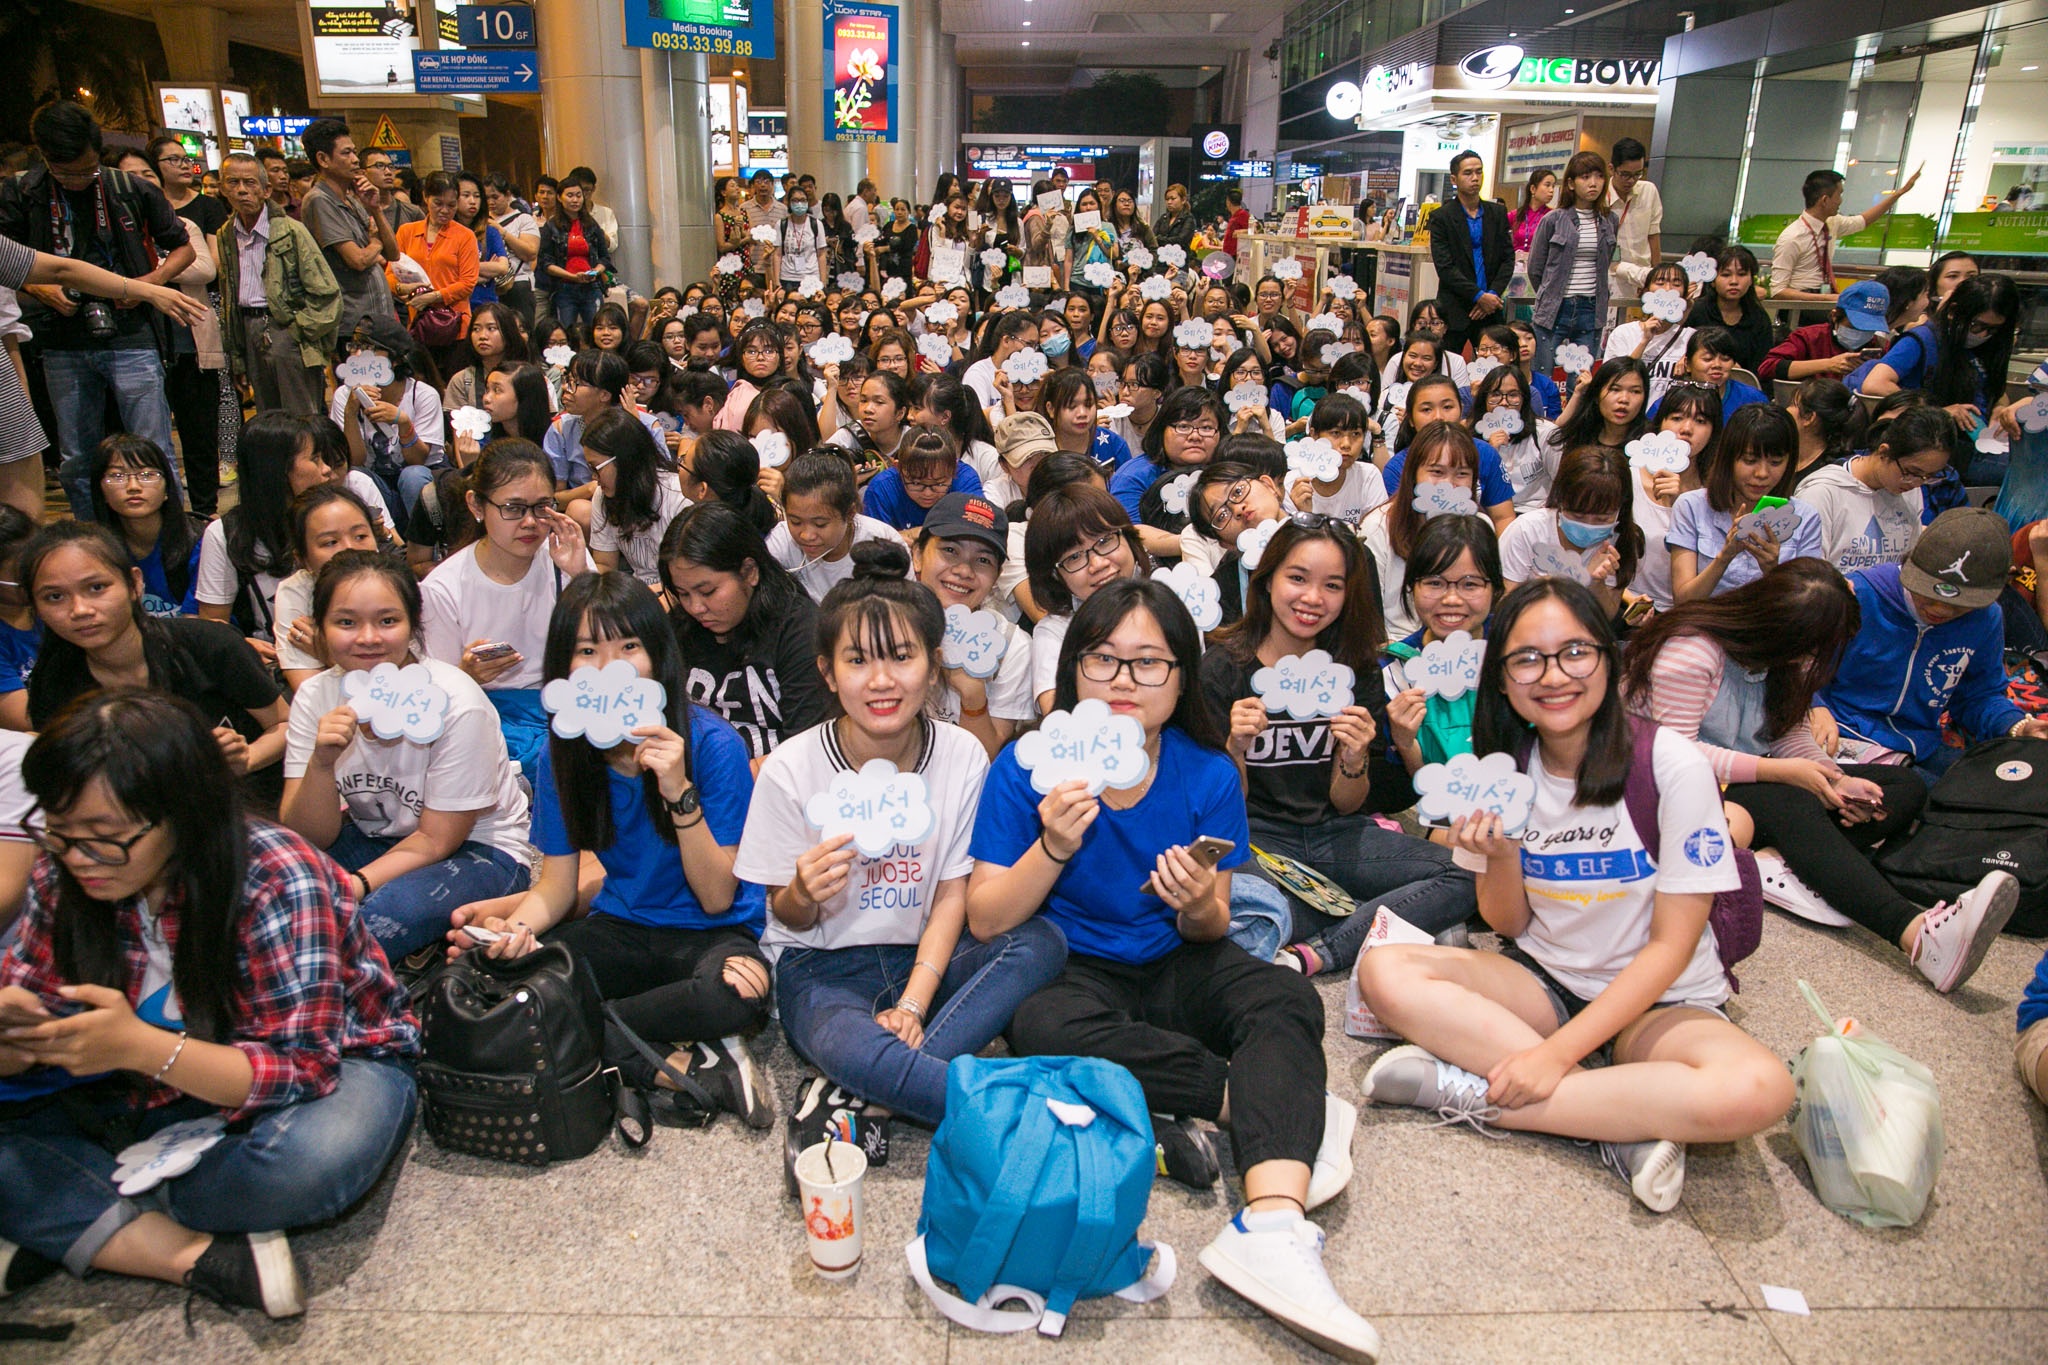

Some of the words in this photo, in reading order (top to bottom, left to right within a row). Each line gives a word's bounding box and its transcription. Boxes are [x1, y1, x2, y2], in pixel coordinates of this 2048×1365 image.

[476, 10, 514, 40] 10
[515, 31, 529, 41] GF
[859, 9, 882, 17] STAR
[652, 31, 752, 56] 0933.33.99.88
[672, 22, 698, 34] Media
[699, 25, 733, 39] Booking
[441, 55, 450, 64] XE
[487, 76, 510, 84] SERVICE
[758, 118, 775, 133] 11
[1208, 142, 1227, 152] KING
[1428, 652, 1479, 680] 예성
[1279, 675, 1336, 704] 예성
[369, 685, 431, 726] 예성
[575, 692, 645, 728] 예성
[1051, 732, 1121, 772] 예성
[1246, 725, 1338, 760] DEVI
[838, 789, 909, 829] 예성
[1447, 779, 1516, 816] 예성
[1540, 826, 1595, 850] years
[1599, 823, 1620, 849] of
[1554, 860, 1571, 876] &
[1578, 857, 1613, 876] ELF
[1981, 857, 2019, 868] CONVERSE
[859, 887, 922, 911] SEOUL
